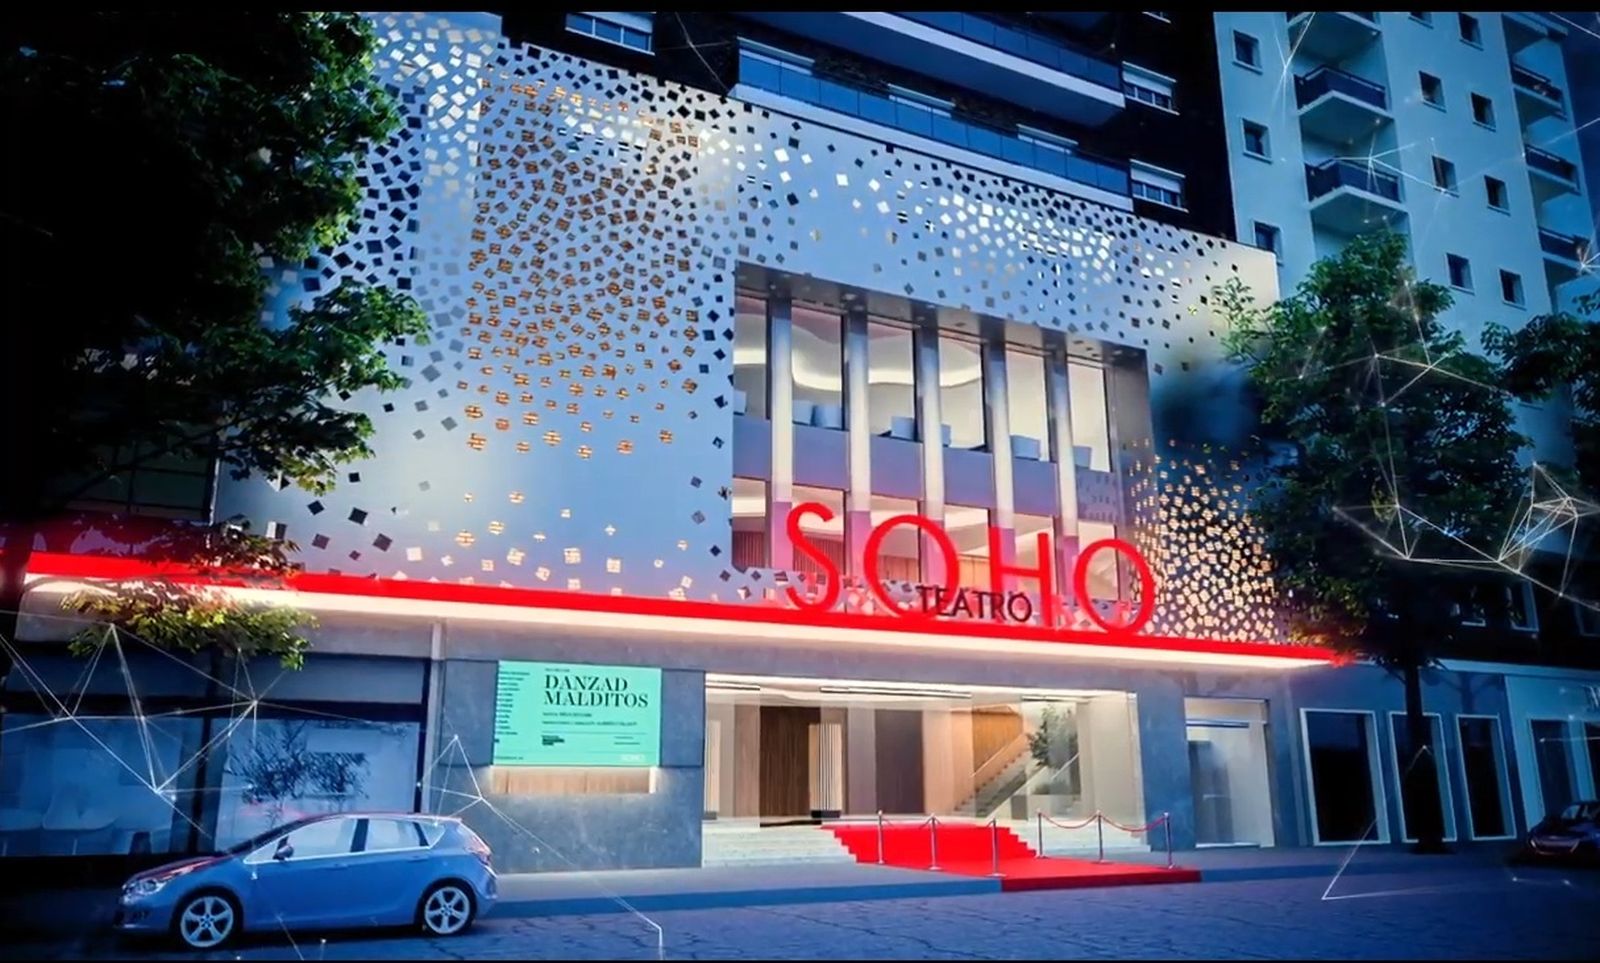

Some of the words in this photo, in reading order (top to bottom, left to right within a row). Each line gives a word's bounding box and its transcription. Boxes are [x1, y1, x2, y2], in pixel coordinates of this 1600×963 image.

[786, 502, 1156, 635] SOHO
[915, 585, 1033, 622] TEATRO
[545, 674, 628, 692] DANZAD
[544, 691, 649, 708] MALDITOS
